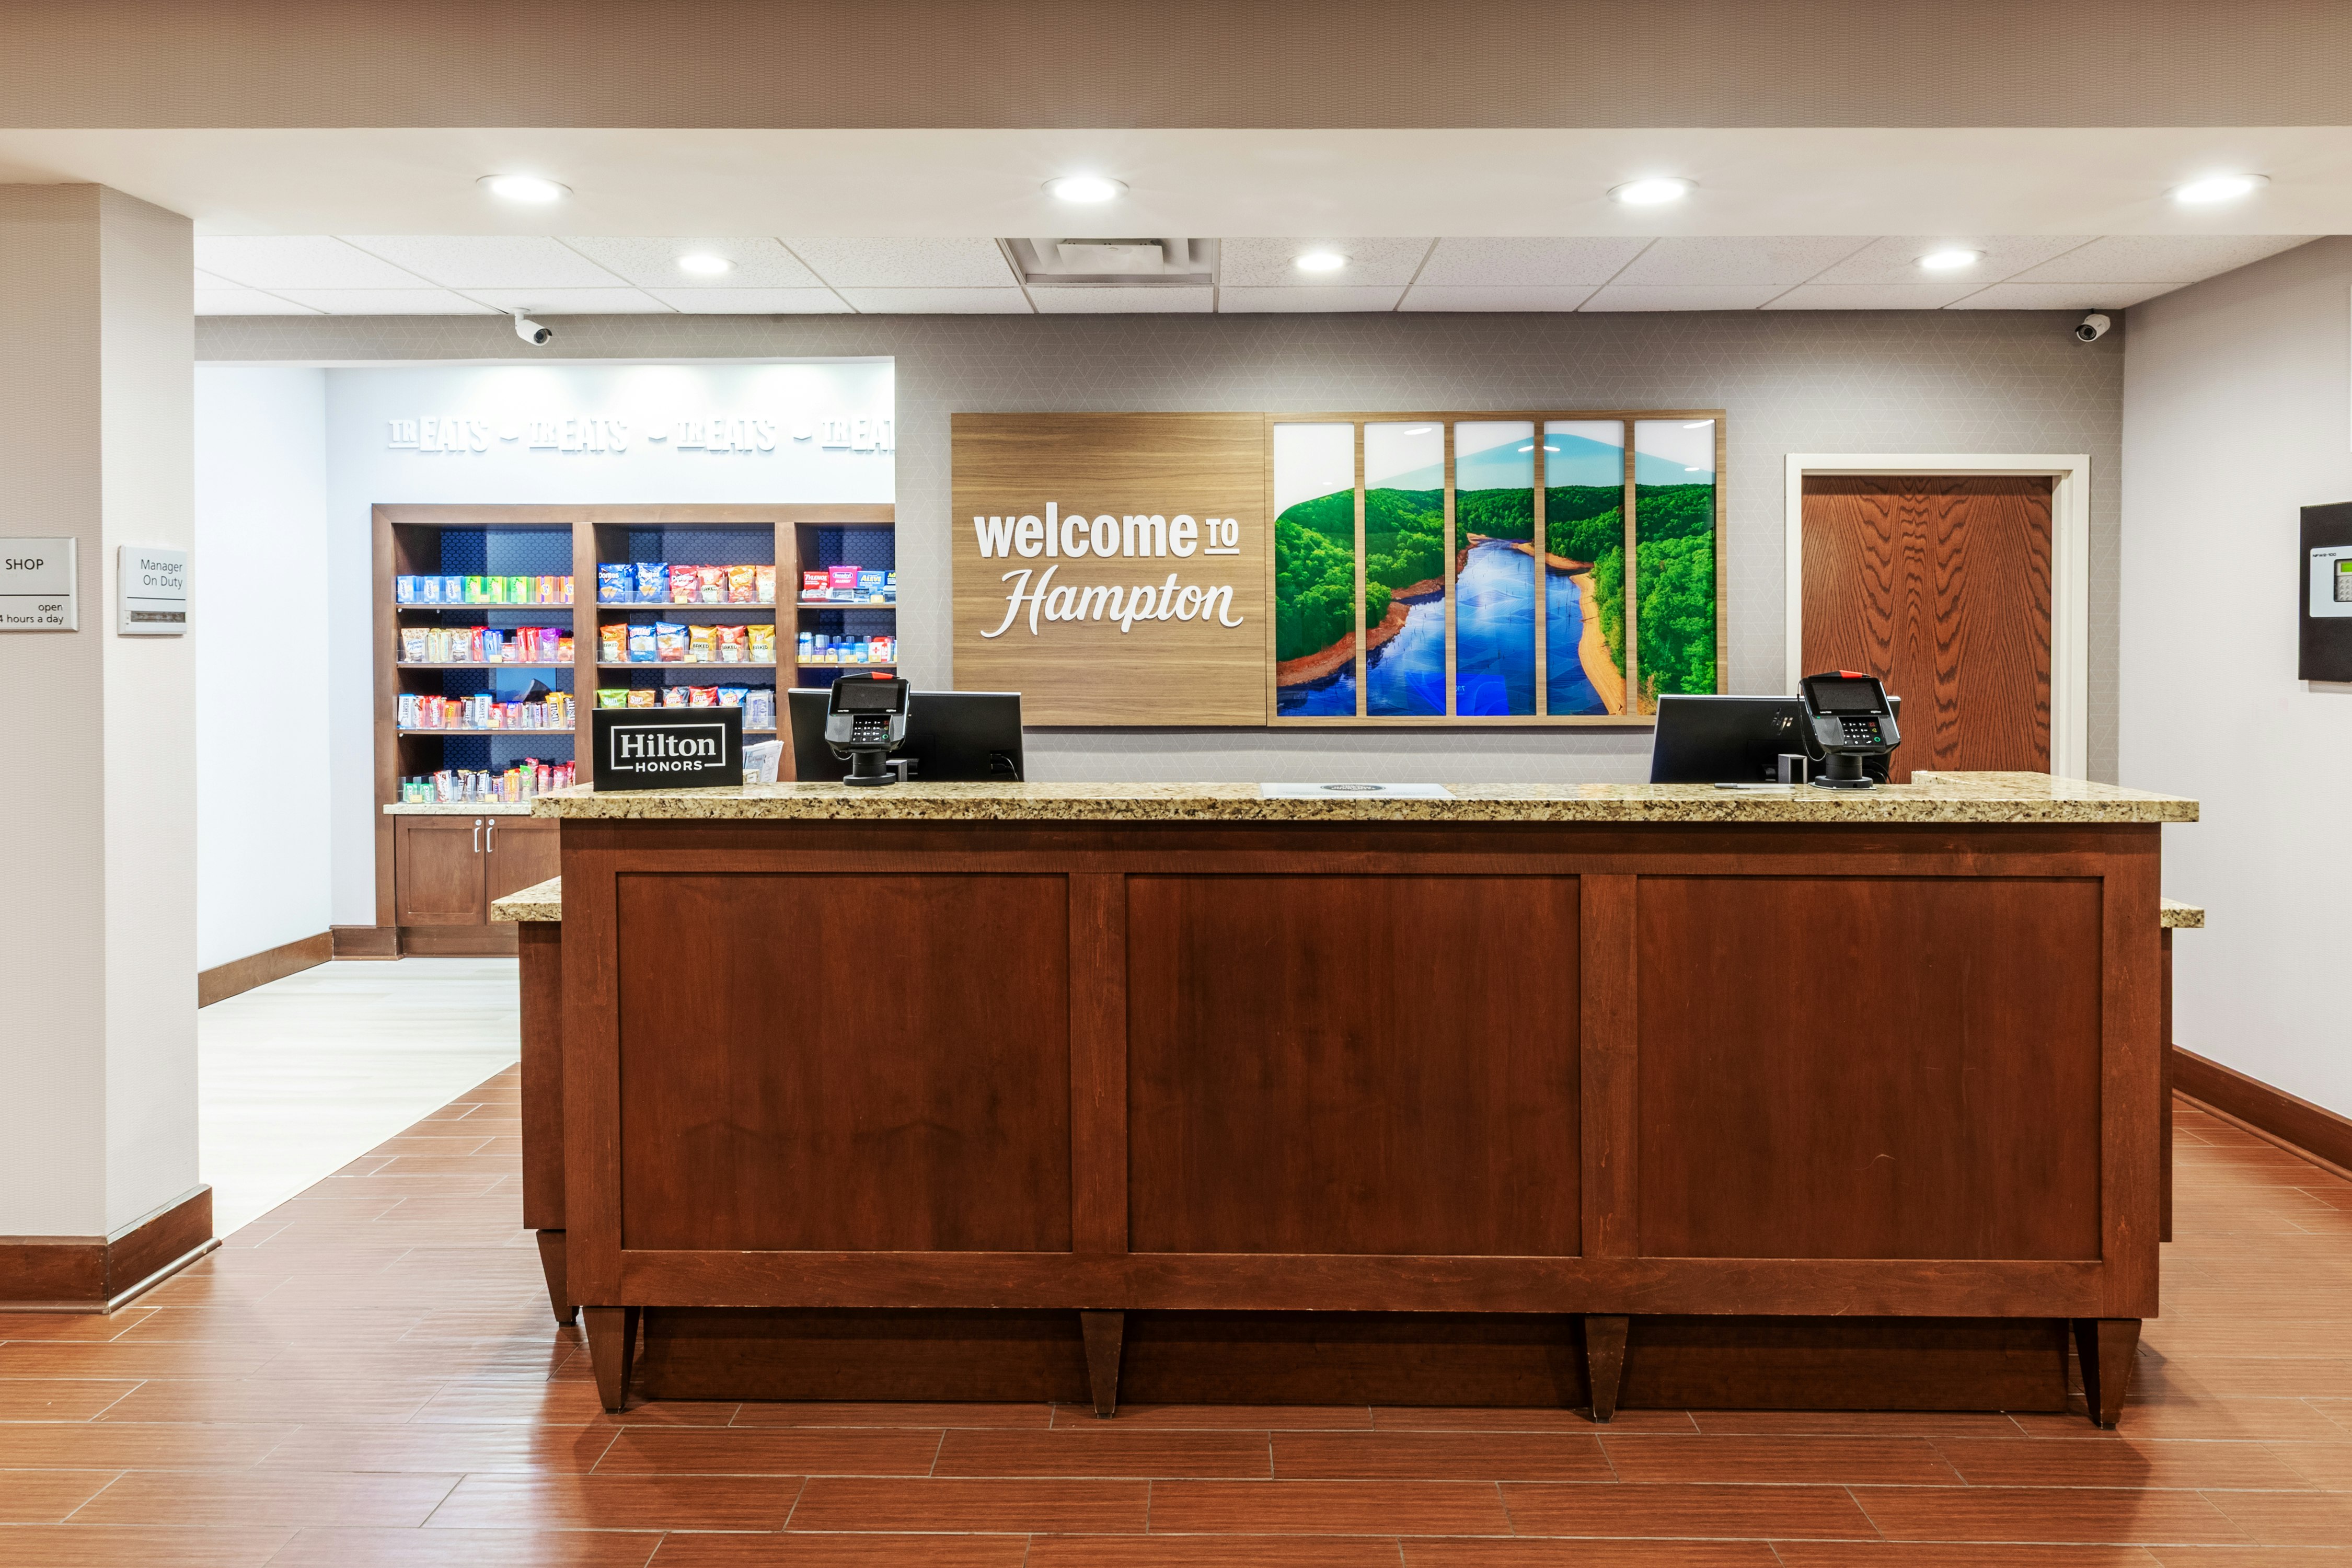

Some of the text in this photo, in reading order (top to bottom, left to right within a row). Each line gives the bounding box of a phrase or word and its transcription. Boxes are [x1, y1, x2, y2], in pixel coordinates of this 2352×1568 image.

[389, 416, 489, 452] TREATS
[528, 416, 628, 452] TREATS
[677, 416, 776, 452] TREATS
[974, 502, 1239, 557] welcome TO
[6, 559, 44, 570] SHOP
[141, 559, 183, 574] Manager
[143, 575, 183, 590] On Duty
[981, 564, 1243, 638] Hampton
[7, 614, 34, 622] hours
[47, 614, 63, 625] day
[621, 734, 716, 758] Hilton
[636, 760, 702, 773] HONORS
